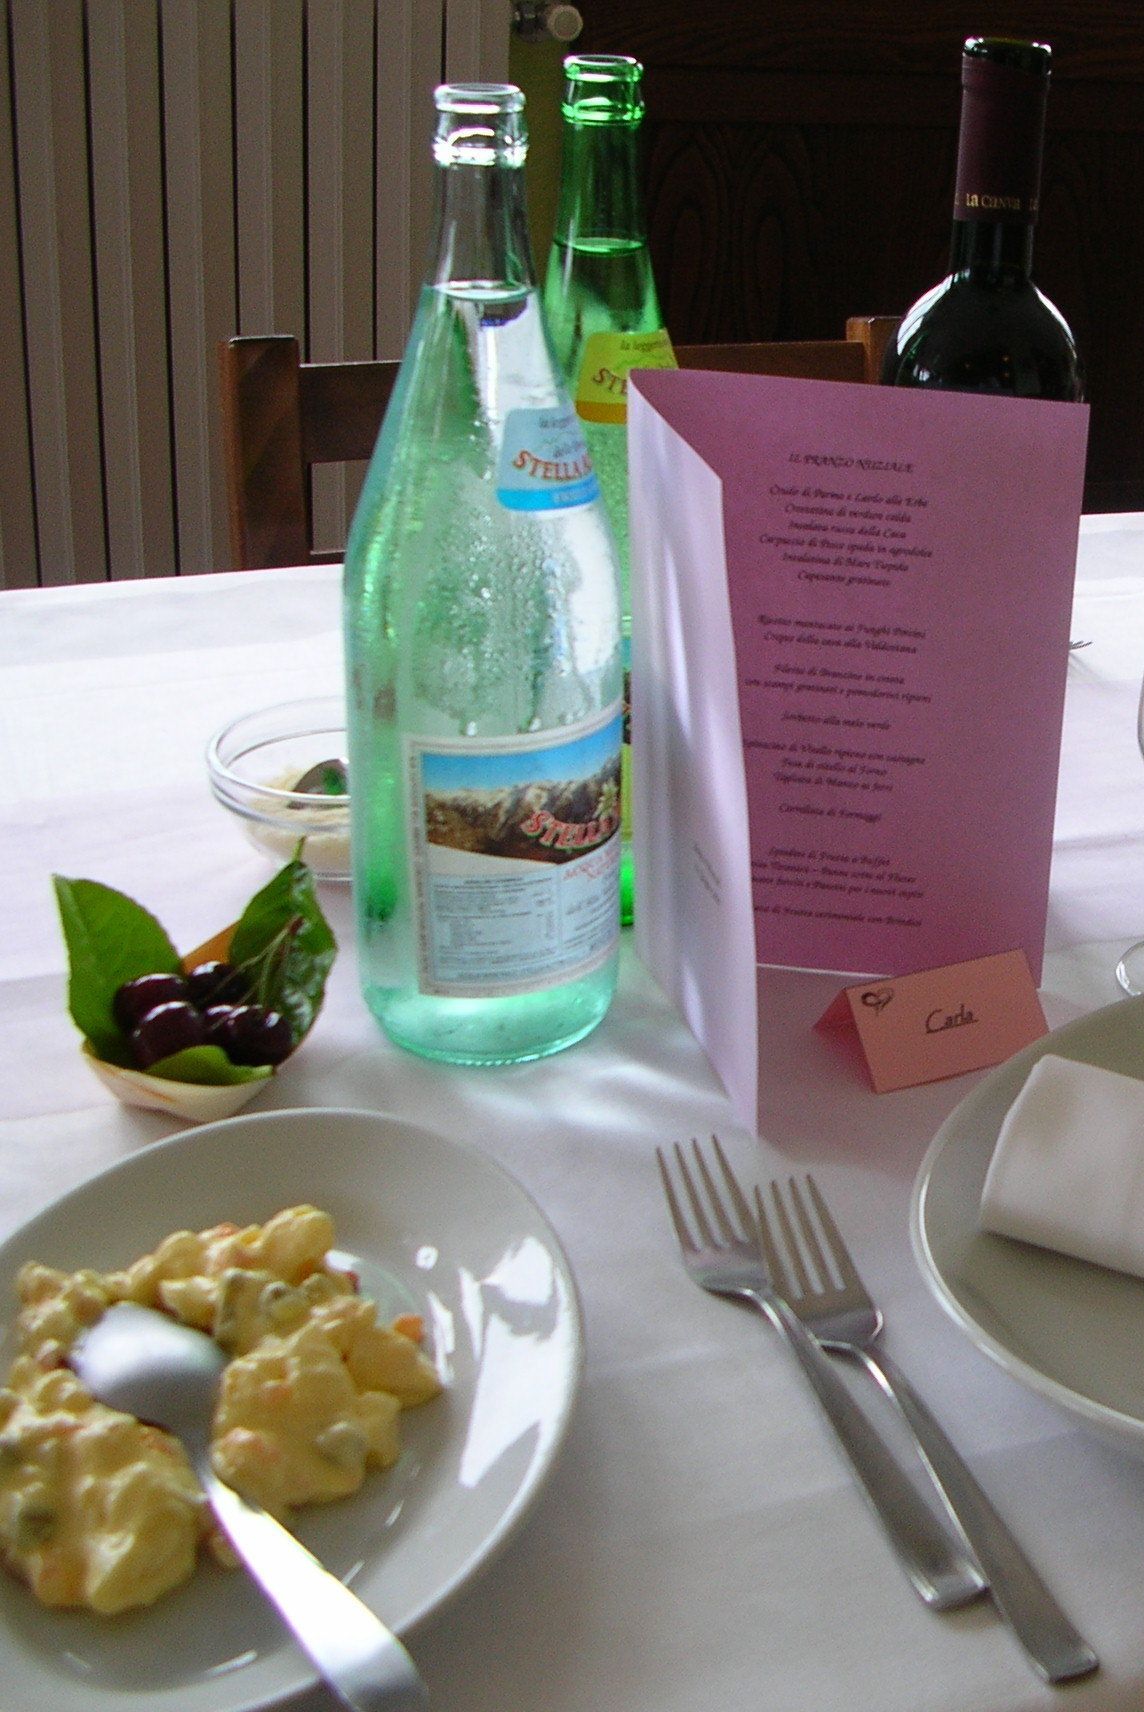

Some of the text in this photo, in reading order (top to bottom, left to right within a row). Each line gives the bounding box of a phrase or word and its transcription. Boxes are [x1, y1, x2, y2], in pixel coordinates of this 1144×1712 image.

[803, 454, 855, 468] PRANZO
[855, 458, 914, 473] NUZIALE
[924, 1003, 977, 1034] Carla
